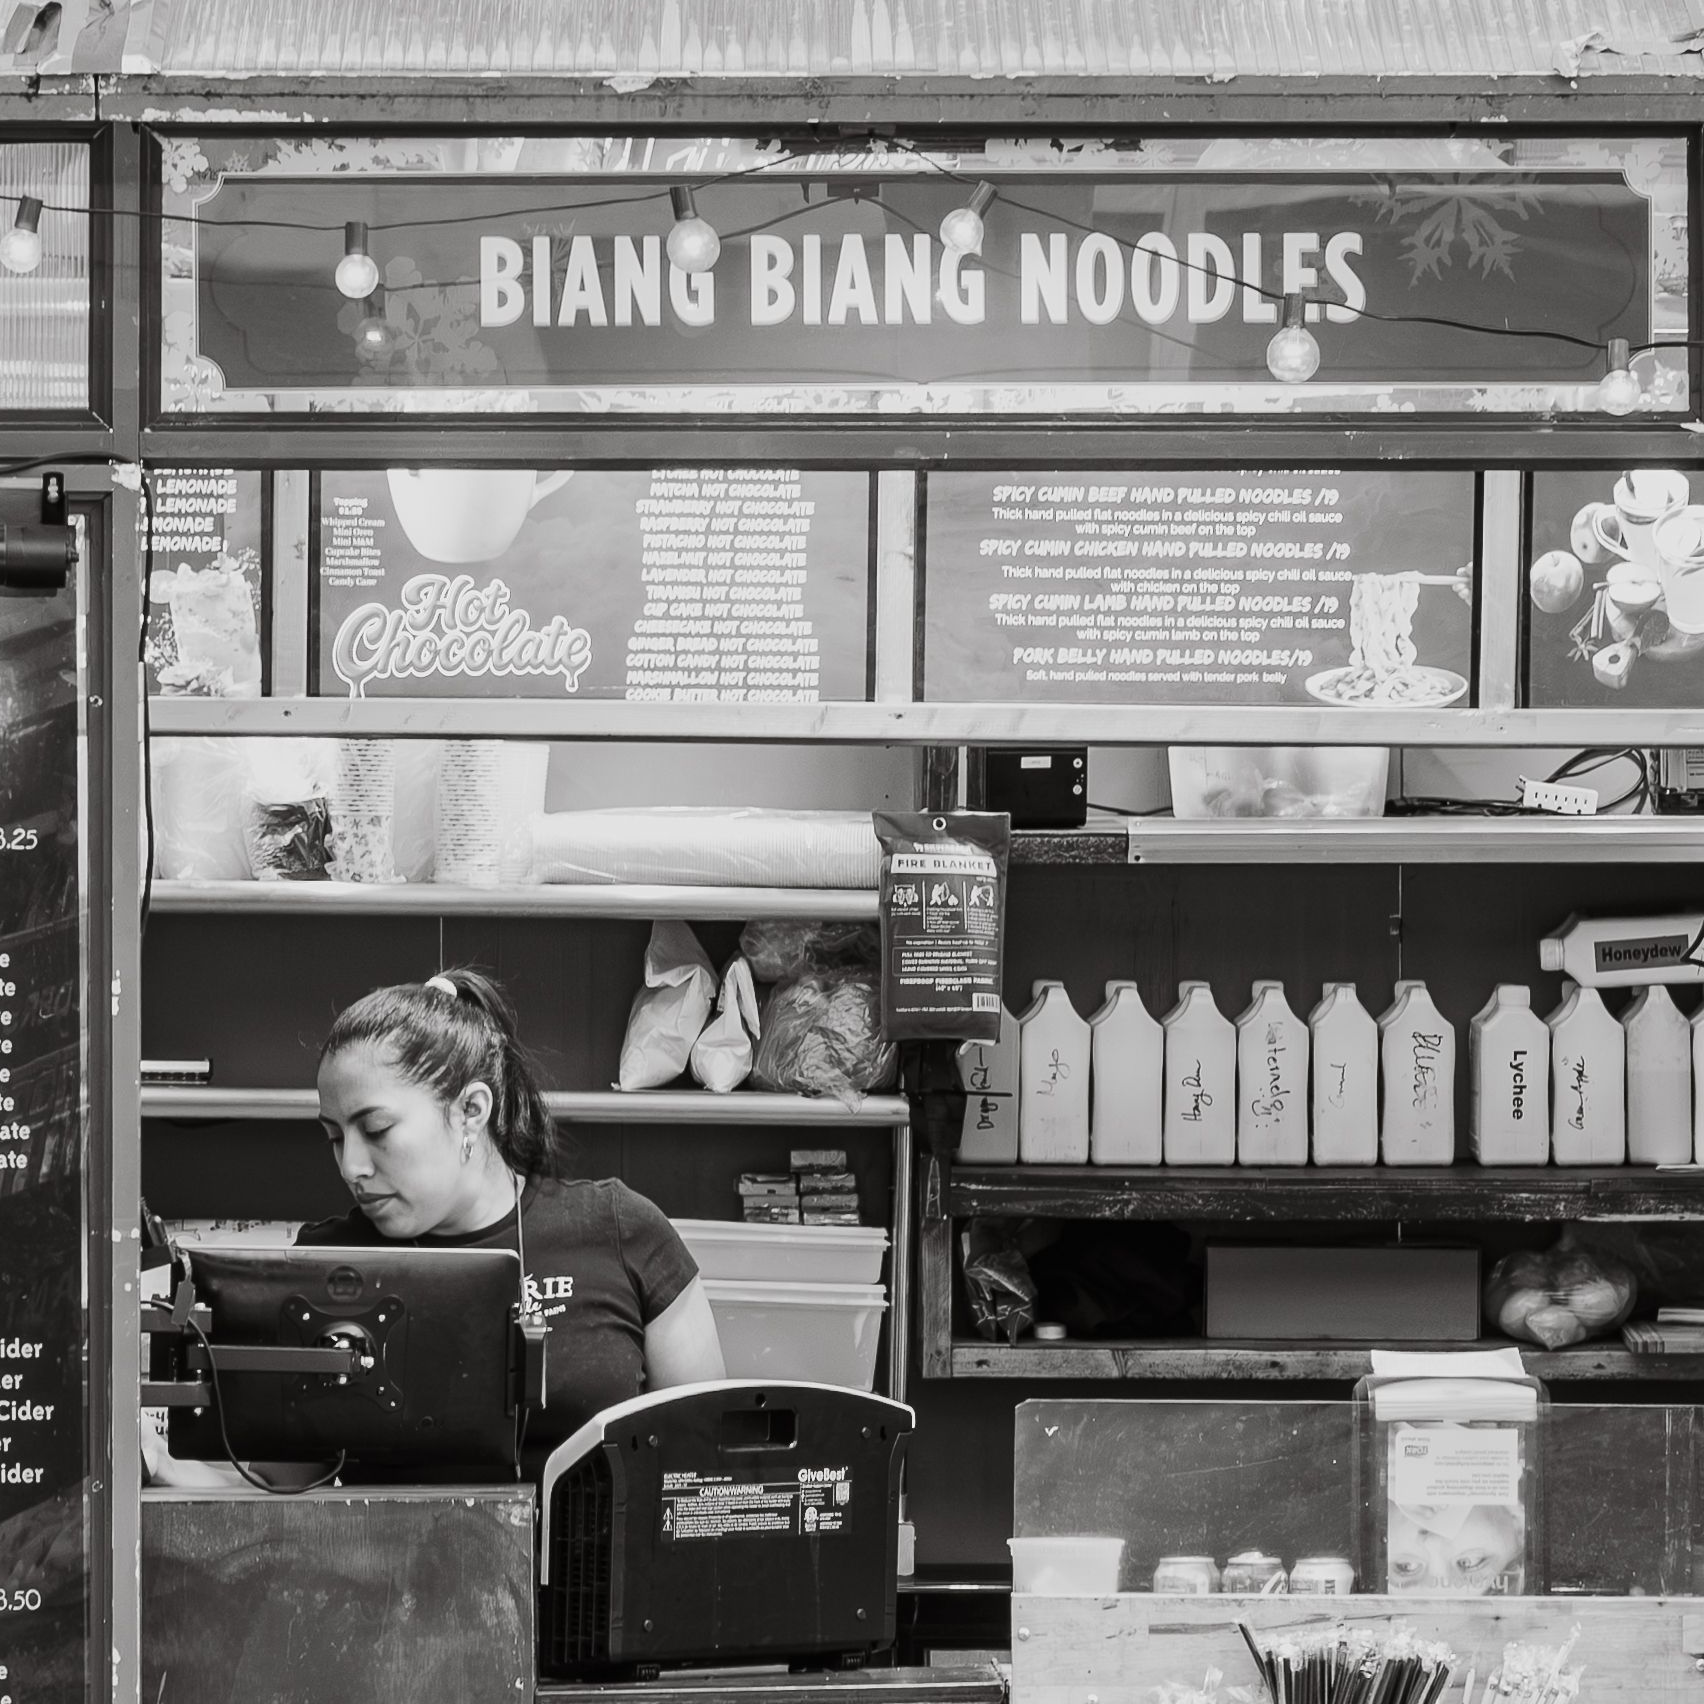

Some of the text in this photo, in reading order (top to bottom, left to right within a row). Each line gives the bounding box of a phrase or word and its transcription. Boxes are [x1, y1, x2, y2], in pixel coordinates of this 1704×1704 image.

[480, 232, 1366, 327] BIANG BIANG NOODLES
[156, 479, 237, 495] LEMONADE
[993, 486, 1035, 502] SPICY
[1038, 487, 1084, 502] CUMIN
[1088, 487, 1127, 503] BEEF
[1130, 487, 1174, 504] HAND
[1178, 488, 1235, 504] PULLED
[1239, 488, 1312, 504] NOODLES
[156, 497, 237, 514] LEMONADE
[1075, 521, 1100, 534] with
[1101, 522, 1132, 538] spicy
[1132, 522, 1169, 537] cumin
[1170, 522, 1197, 536] beef
[1215, 523, 1235, 536] the
[1236, 523, 1257, 538] top
[708, 569, 734, 583] HOT
[735, 570, 806, 584] CHOCOLATE
[402, 574, 510, 632] Hot
[333, 600, 591, 684] Chocolate
[626, 654, 820, 670] COTTON CANDY HOT CHOCOLATE
[1014, 648, 1054, 665] PORK
[1057, 648, 1106, 665] BELLY
[1110, 648, 1153, 665] HAND
[1157, 649, 1215, 665] PULLED
[897, 858, 926, 869] FIRE
[1601, 944, 1682, 963] Honeydew
[1510, 1050, 1528, 1120] Lychee
